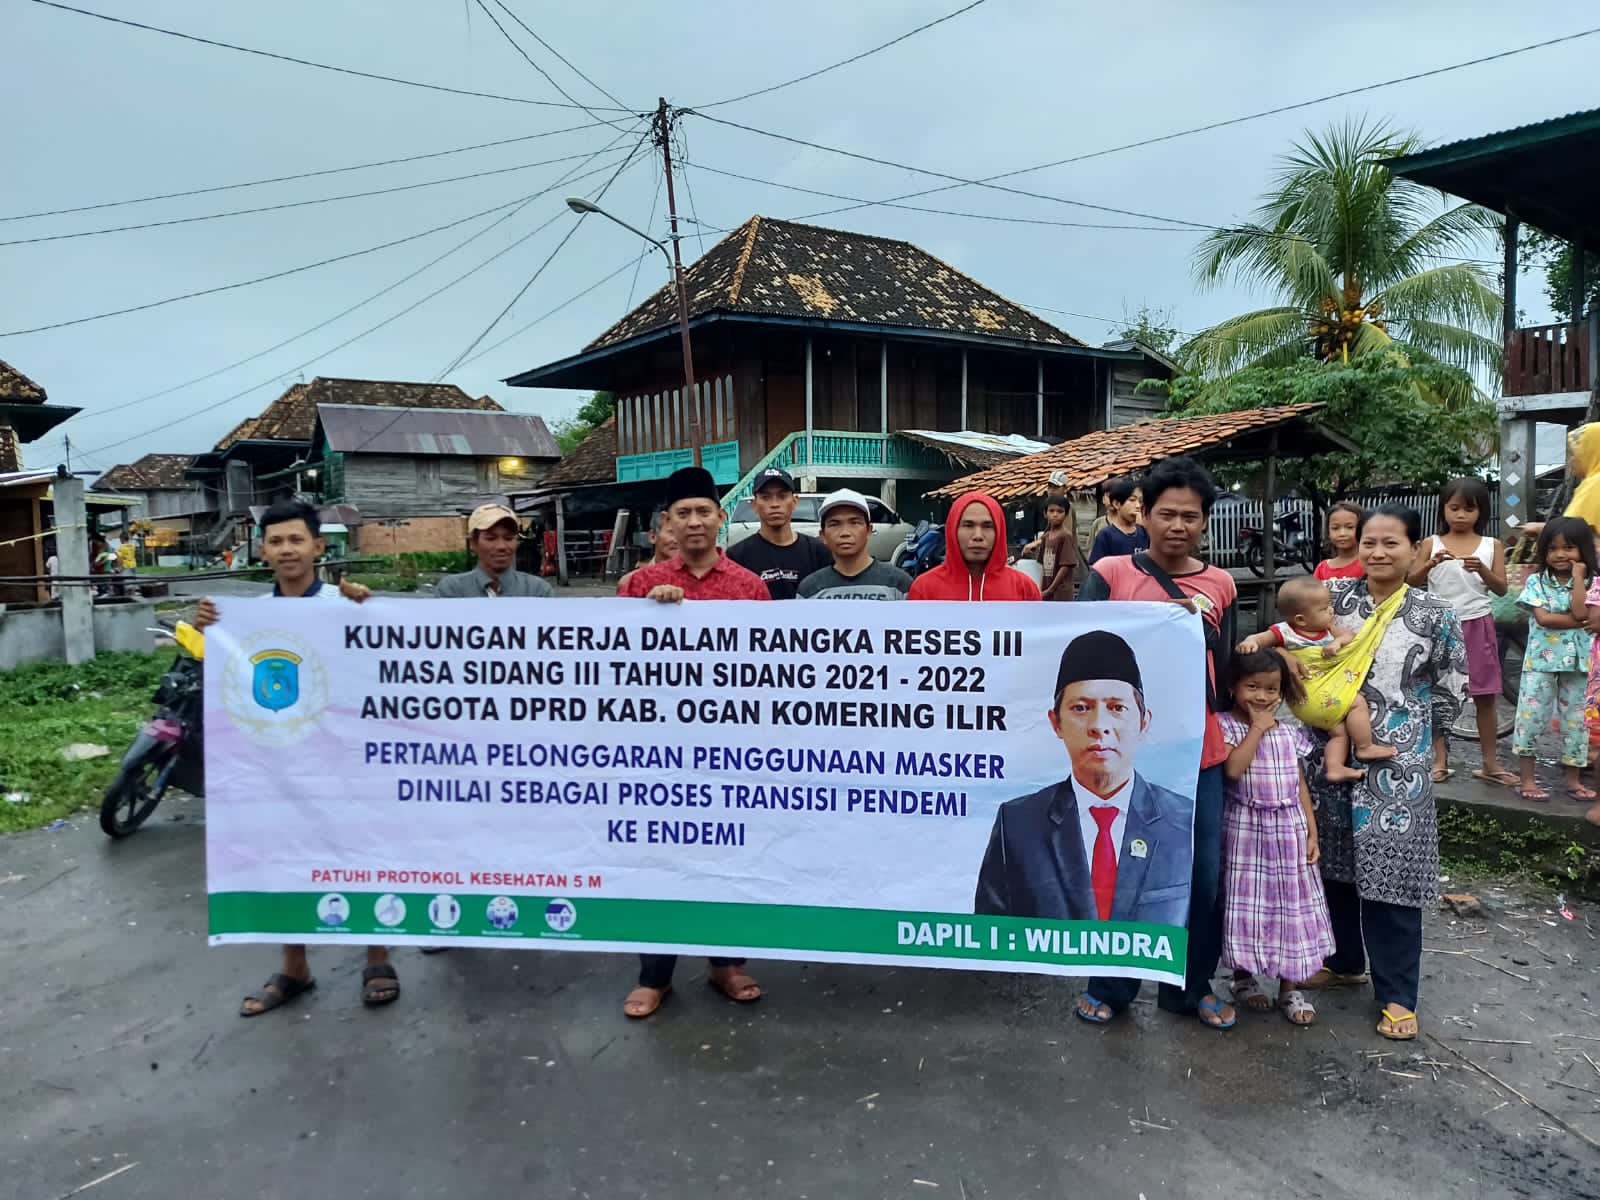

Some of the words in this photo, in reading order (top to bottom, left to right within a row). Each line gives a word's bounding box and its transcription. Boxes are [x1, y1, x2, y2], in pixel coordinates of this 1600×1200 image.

[345, 625, 526, 650] KUNJUNGAN
[537, 626, 631, 651] KERJA
[642, 627, 738, 652] DALAM
[750, 628, 873, 654] RANGKA
[884, 630, 982, 656] RESES
[993, 631, 1022, 657] III
[379, 660, 454, 684] MASA
[463, 661, 564, 686] SIDANG
[575, 662, 599, 686] III
[610, 662, 703, 687] TAHUN
[713, 663, 816, 689] SIDANG
[825, 665, 888, 690] 2021
[917, 666, 985, 693] 2022
[361, 695, 498, 721] ANGGOTA
[510, 698, 587, 722] DPRD
[598, 699, 666, 723] KAB.
[677, 699, 760, 725] OGAN
[772, 701, 935, 729] KOMERING
[946, 704, 1007, 731] ILIR
[365, 741, 478, 766] PERTAMA
[487, 743, 683, 769] PELONGGARAN
[694, 745, 885, 775] PENGGUNAAN
[895, 751, 1005, 780] MASKER
[397, 778, 491, 803] DINILAI
[501, 780, 608, 805] SEBAGAI
[618, 782, 713, 808] PROSES
[721, 784, 837, 812] TRANSISI
[847, 788, 967, 817] PENDEMI
[607, 819, 638, 843] KE
[647, 820, 745, 847] ENDEMI
[312, 869, 371, 883] PATUHI
[377, 870, 465, 886] PROTOKOL
[470, 872, 567, 888] KESEHATAN
[573, 874, 583, 888] 5
[588, 875, 603, 889] M
[897, 921, 981, 949] DAPIL
[990, 926, 998, 950] I
[1008, 932, 1016, 951] :
[1025, 926, 1173, 961] WILINDRA
